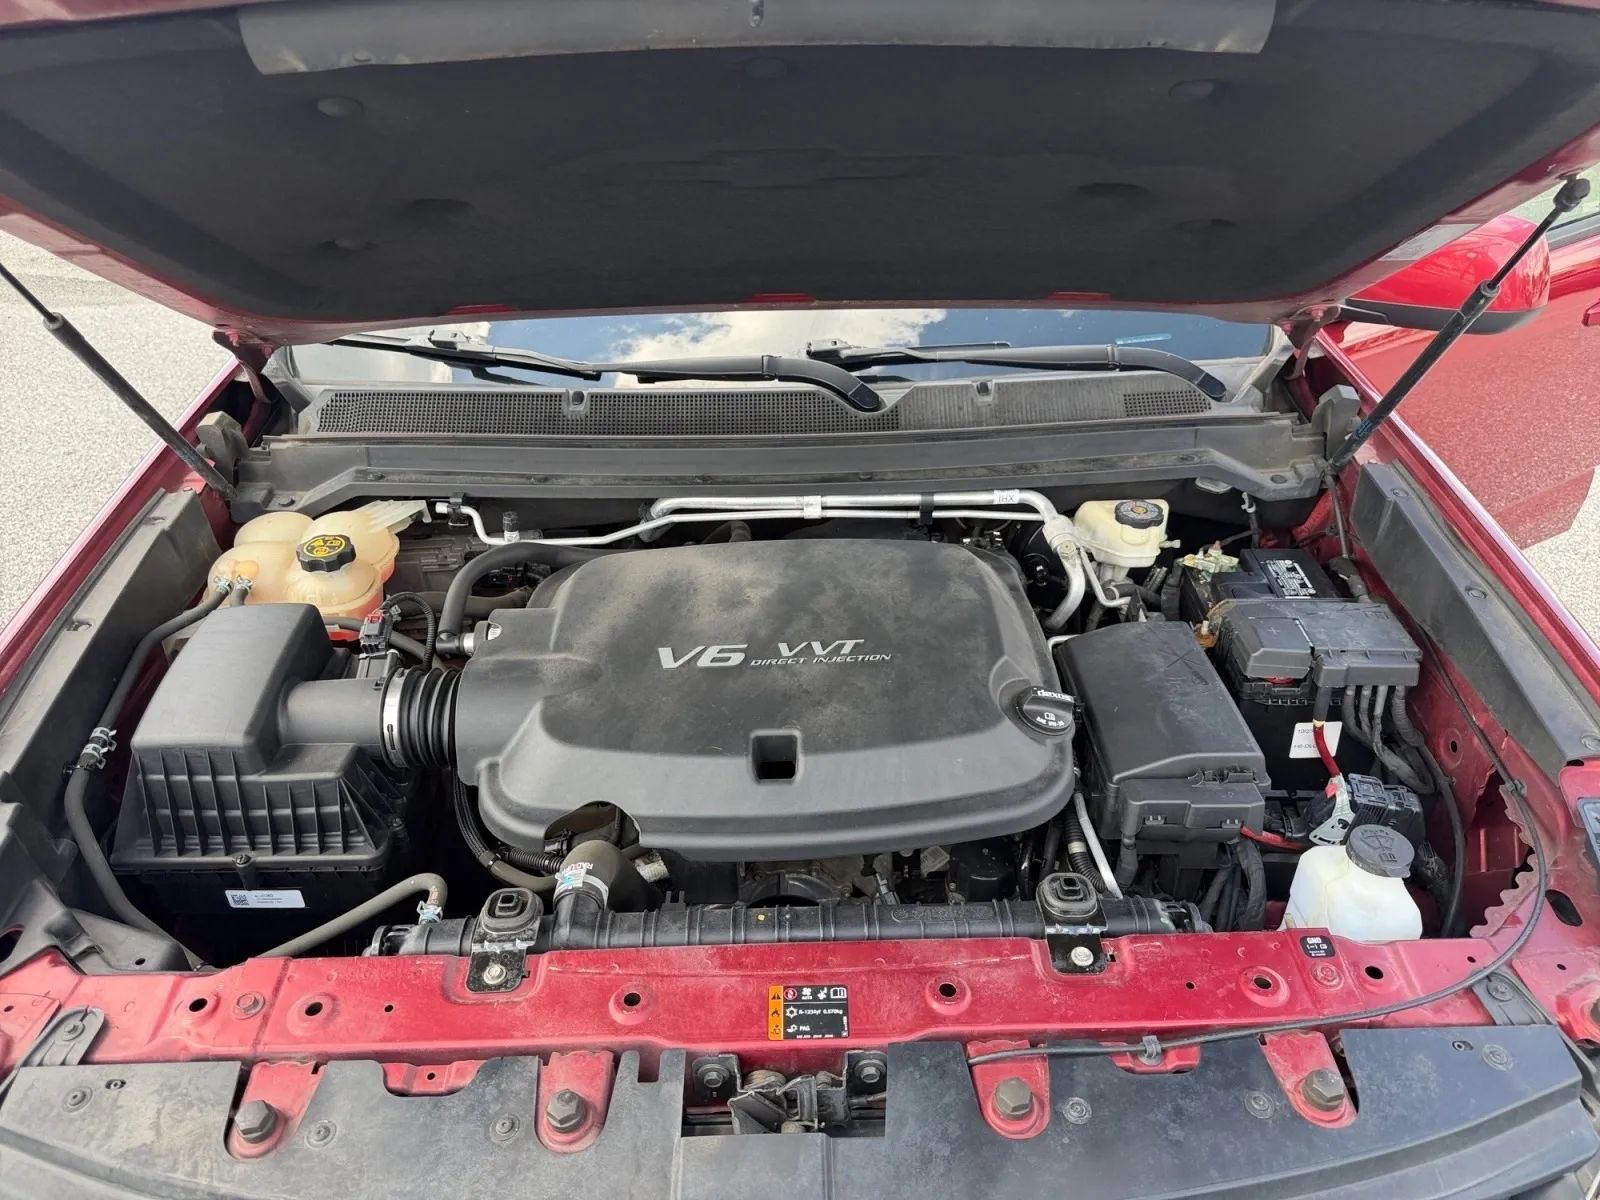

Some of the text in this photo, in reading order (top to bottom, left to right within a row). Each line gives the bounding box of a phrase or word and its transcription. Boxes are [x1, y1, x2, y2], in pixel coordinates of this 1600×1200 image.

[657, 643, 748, 670] V6
[777, 639, 865, 657] VVT
[750, 653, 892, 667] DIRECT INJECTION
